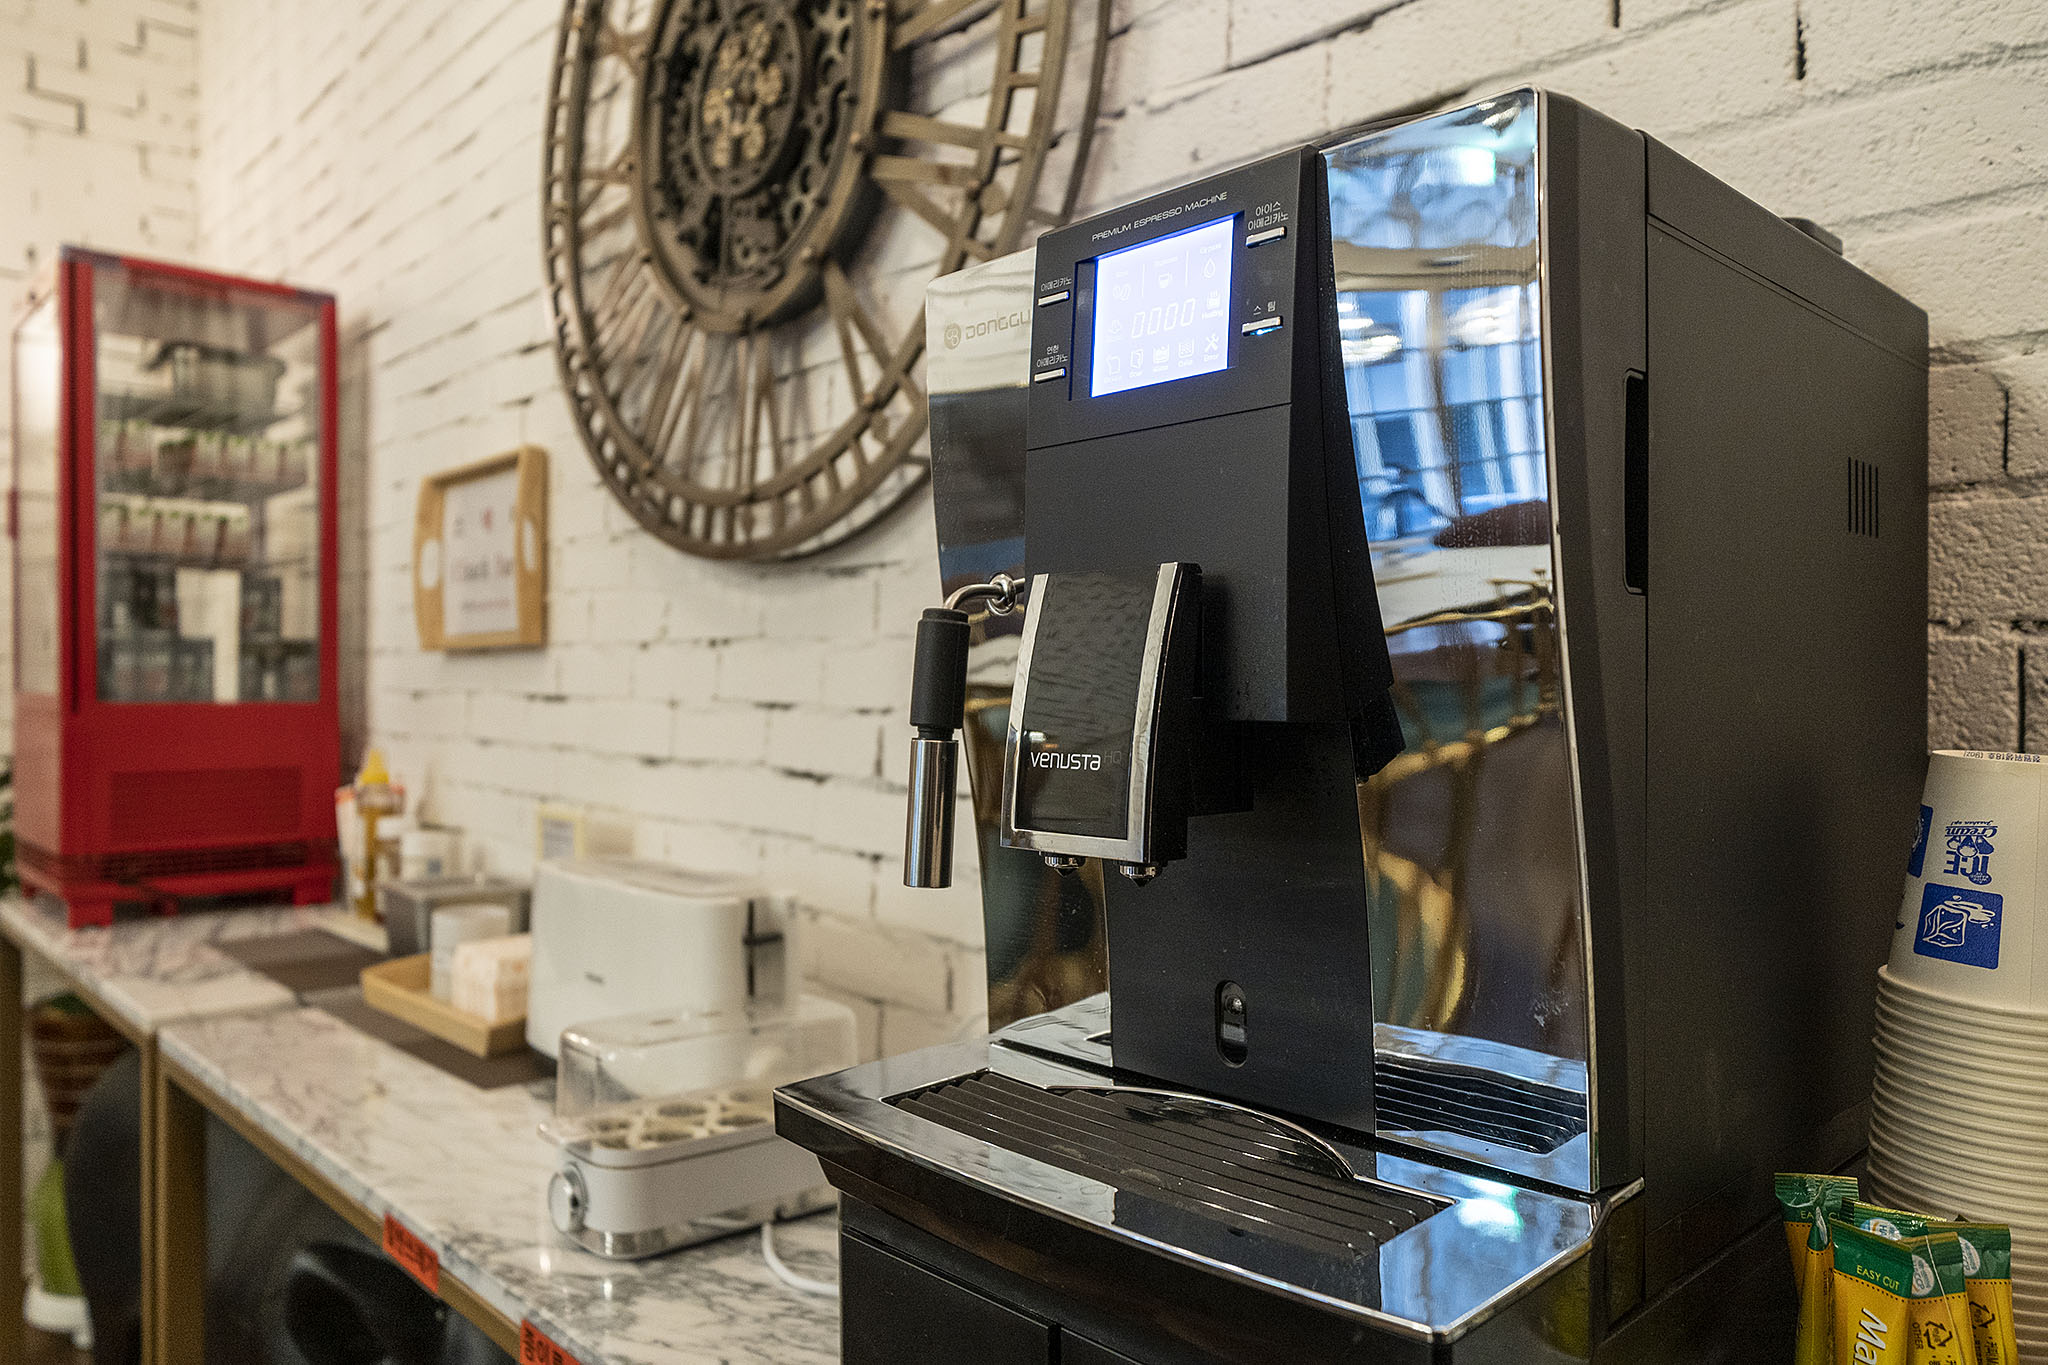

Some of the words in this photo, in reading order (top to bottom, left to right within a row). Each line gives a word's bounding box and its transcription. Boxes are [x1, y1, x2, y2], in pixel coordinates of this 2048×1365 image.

[1091, 223, 1132, 242] PREMIUM
[1133, 206, 1183, 229] ESPRESSO
[1184, 191, 1228, 213] MACHINE
[1255, 201, 1281, 217] 아이스
[1247, 212, 1289, 231] 아메리카노
[1040, 277, 1072, 292] 아메리카노
[1036, 353, 1068, 368] 아메리카노
[1945, 826, 1998, 838] Cream
[1943, 850, 1990, 877] ICE
[1856, 1264, 1881, 1282] EASY
[1882, 1275, 1900, 1291] CUT
[1853, 1307, 1888, 1365] Ma
[1911, 1321, 1924, 1350] OTHER
